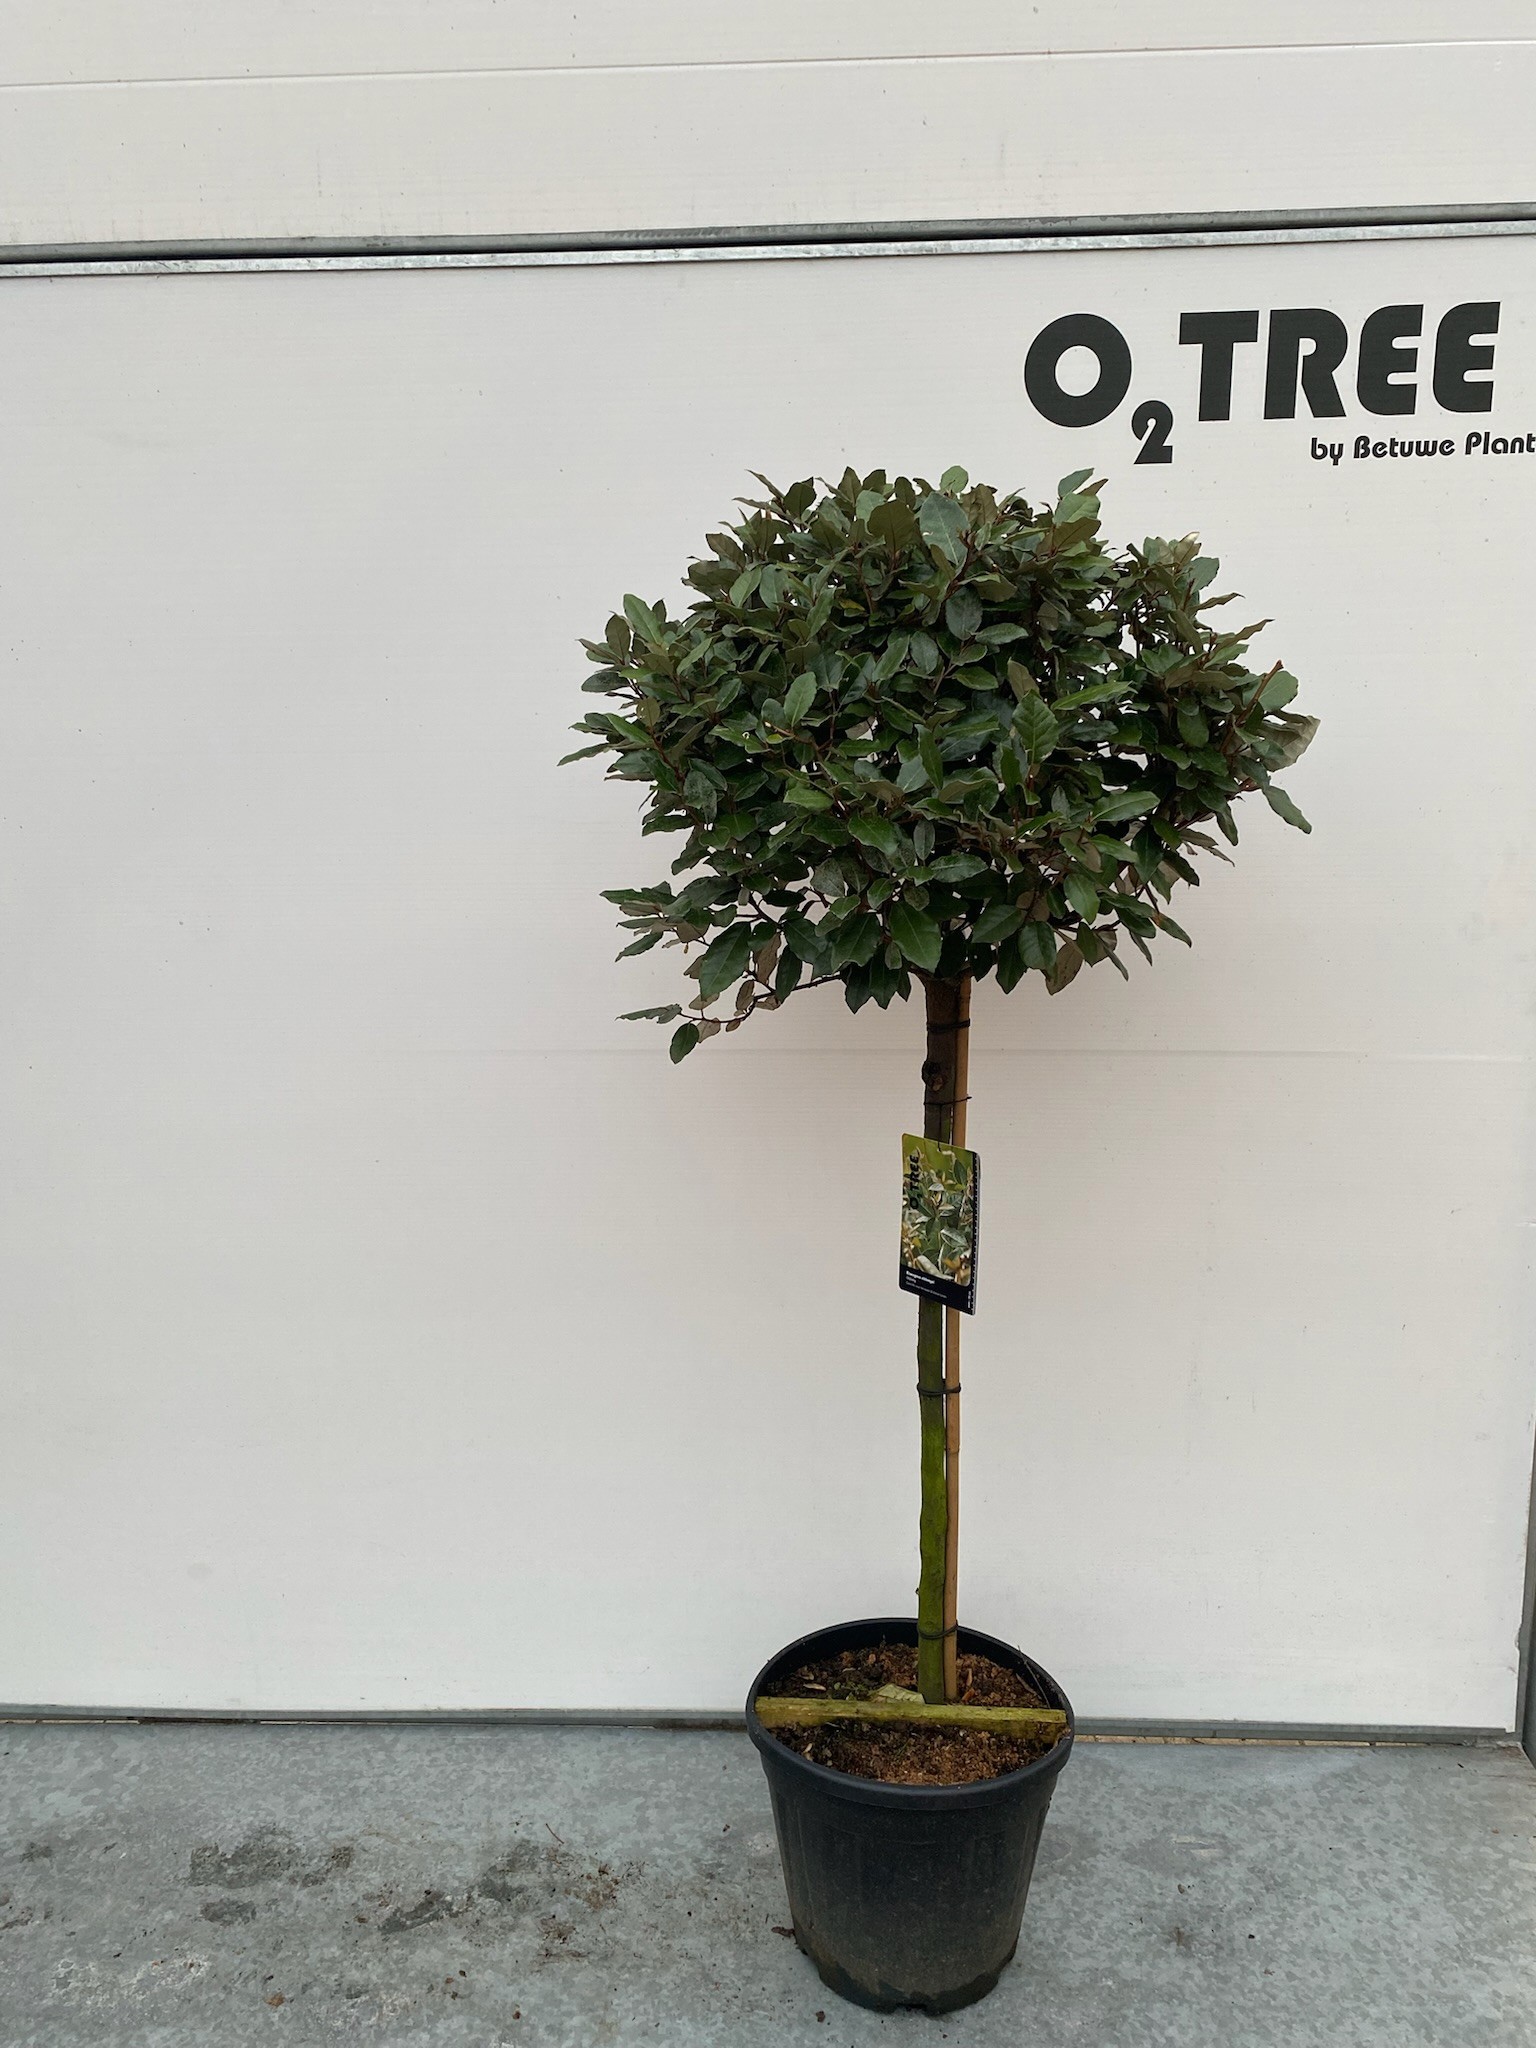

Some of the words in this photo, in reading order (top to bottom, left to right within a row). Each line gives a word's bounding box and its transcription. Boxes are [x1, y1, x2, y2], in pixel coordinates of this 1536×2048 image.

[1310, 437, 1344, 466] by
[1353, 435, 1456, 459] Betuwe
[1464, 431, 1536, 456] Plant
